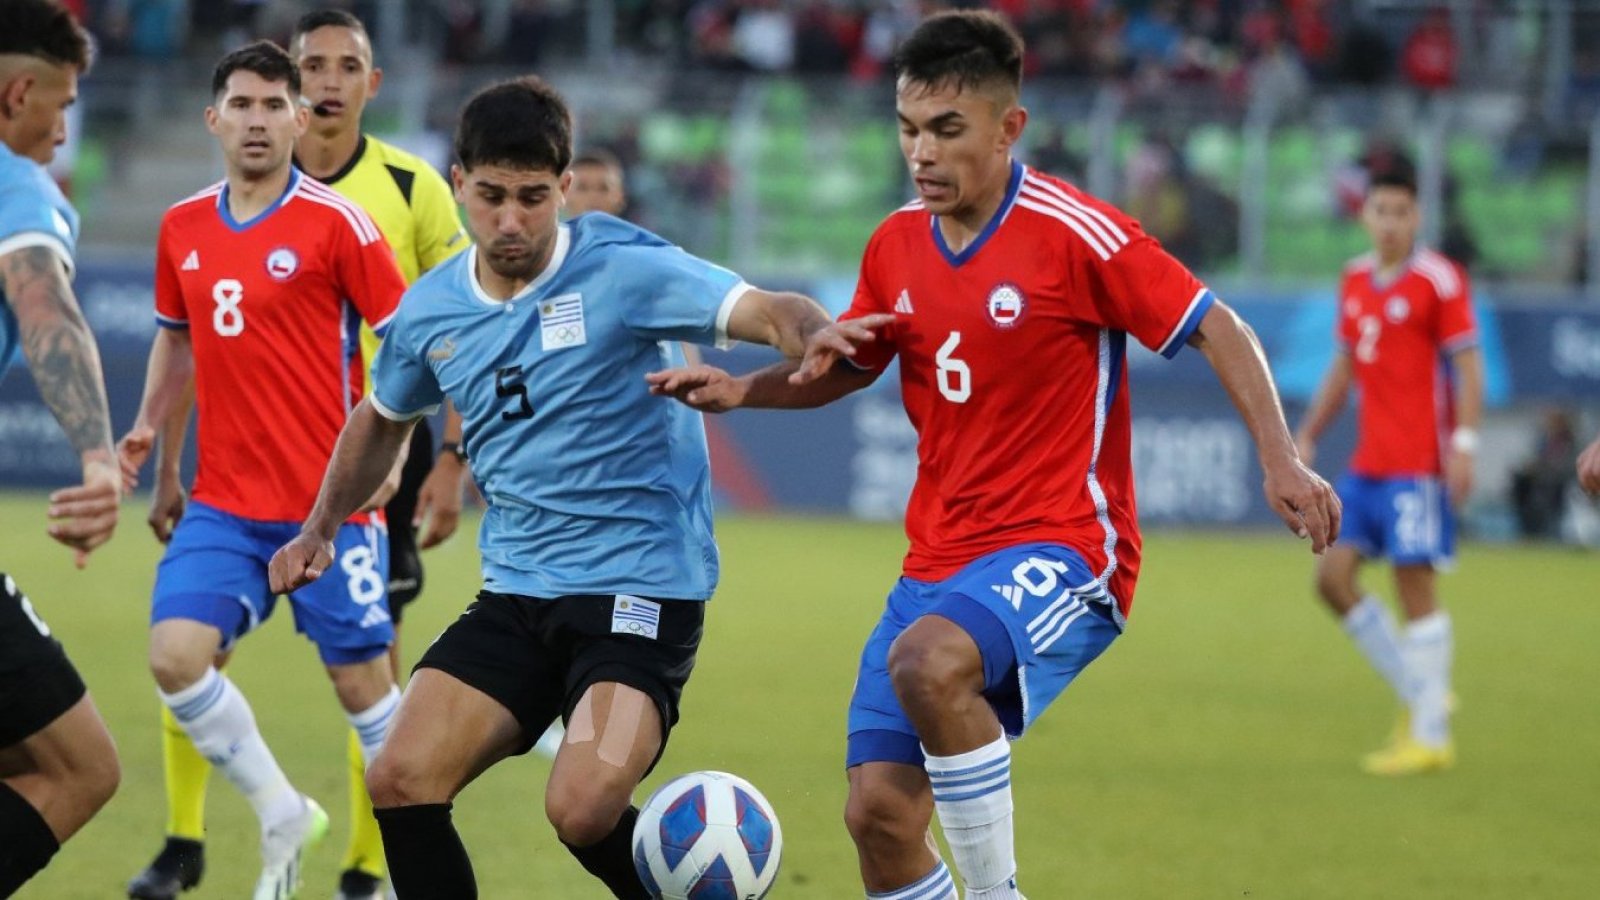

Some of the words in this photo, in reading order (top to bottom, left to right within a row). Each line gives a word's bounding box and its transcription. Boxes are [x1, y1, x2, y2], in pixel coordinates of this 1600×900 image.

[212, 278, 245, 337] 8
[935, 330, 972, 403] 6
[1356, 314, 1381, 364] 2
[495, 365, 535, 421] 5
[340, 544, 385, 605] 8
[1011, 557, 1069, 597] 6
